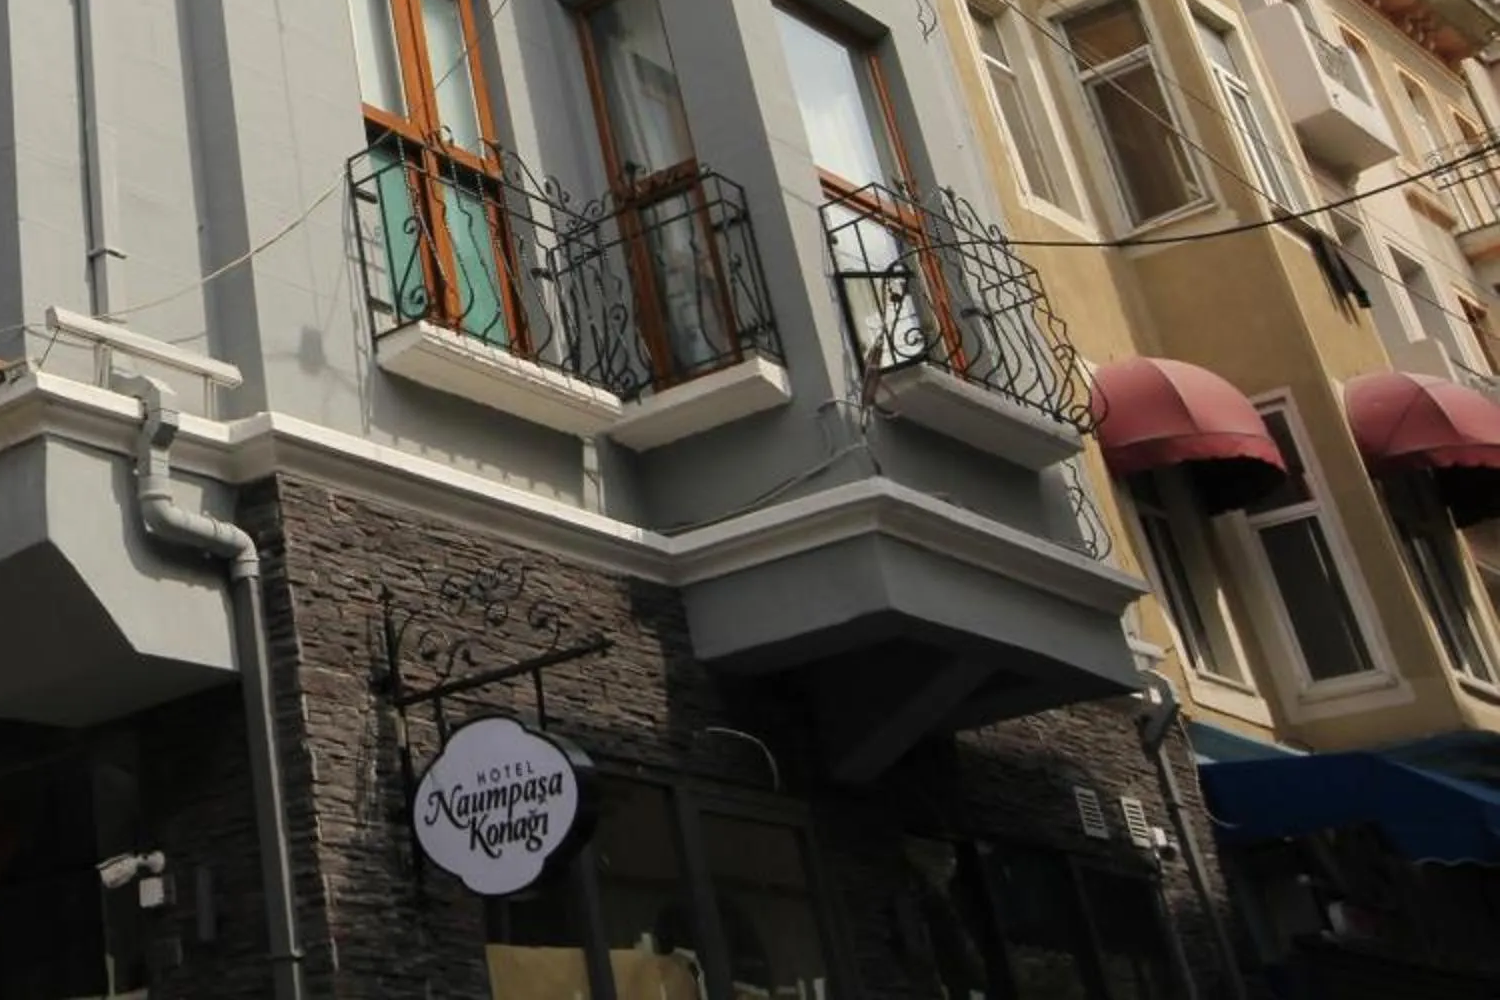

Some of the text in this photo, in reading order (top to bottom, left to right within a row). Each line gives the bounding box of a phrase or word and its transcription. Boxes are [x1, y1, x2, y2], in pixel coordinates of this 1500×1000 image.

[477, 760, 534, 785] HOTEL
[424, 772, 563, 830] Naumpaşa
[469, 810, 549, 859] Konağı
